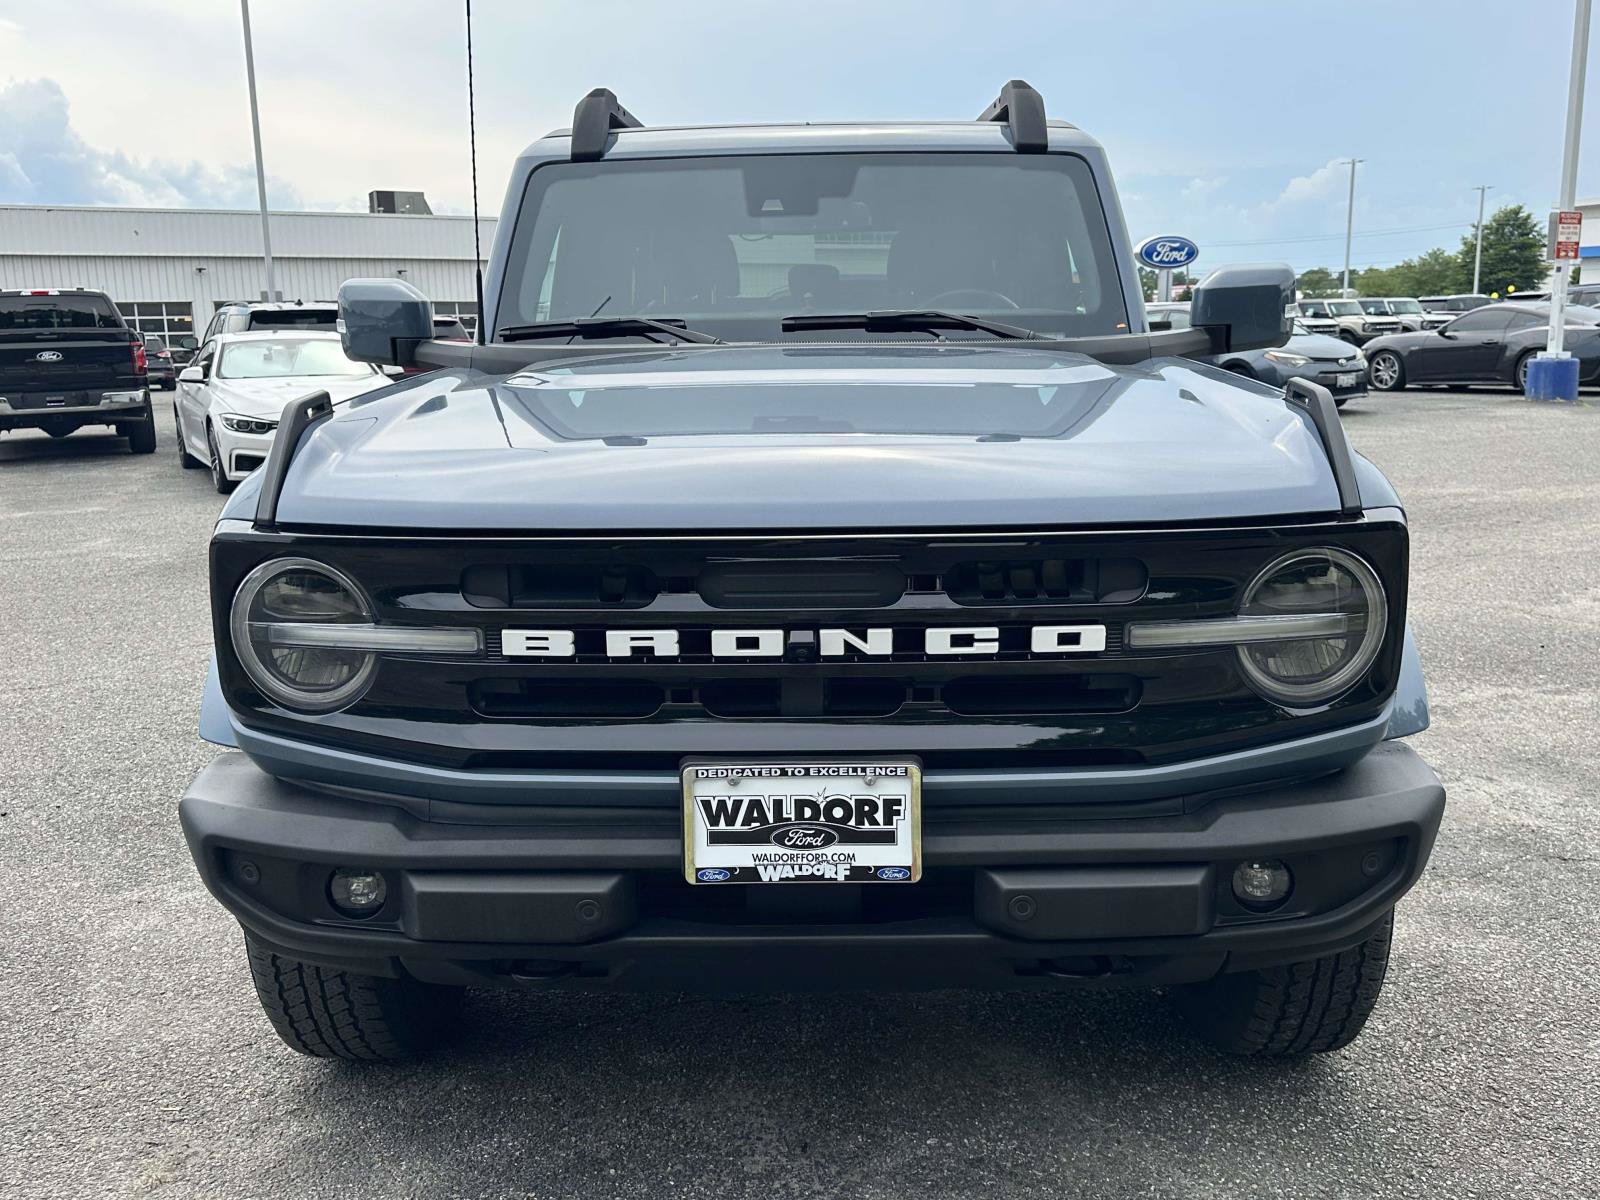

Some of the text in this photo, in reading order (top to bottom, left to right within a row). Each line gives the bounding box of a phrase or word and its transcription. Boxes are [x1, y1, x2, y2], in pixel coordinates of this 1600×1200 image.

[1152, 242, 1188, 262] Ford
[501, 625, 1107, 657] BRONCO
[697, 767, 906, 778] DEDICATED TO EXCELLENCE
[699, 797, 903, 827] WALDORF
[784, 829, 825, 846] Ford
[702, 870, 725, 880] Ford
[755, 862, 851, 881] WALDORF
[882, 869, 904, 879] Ford
